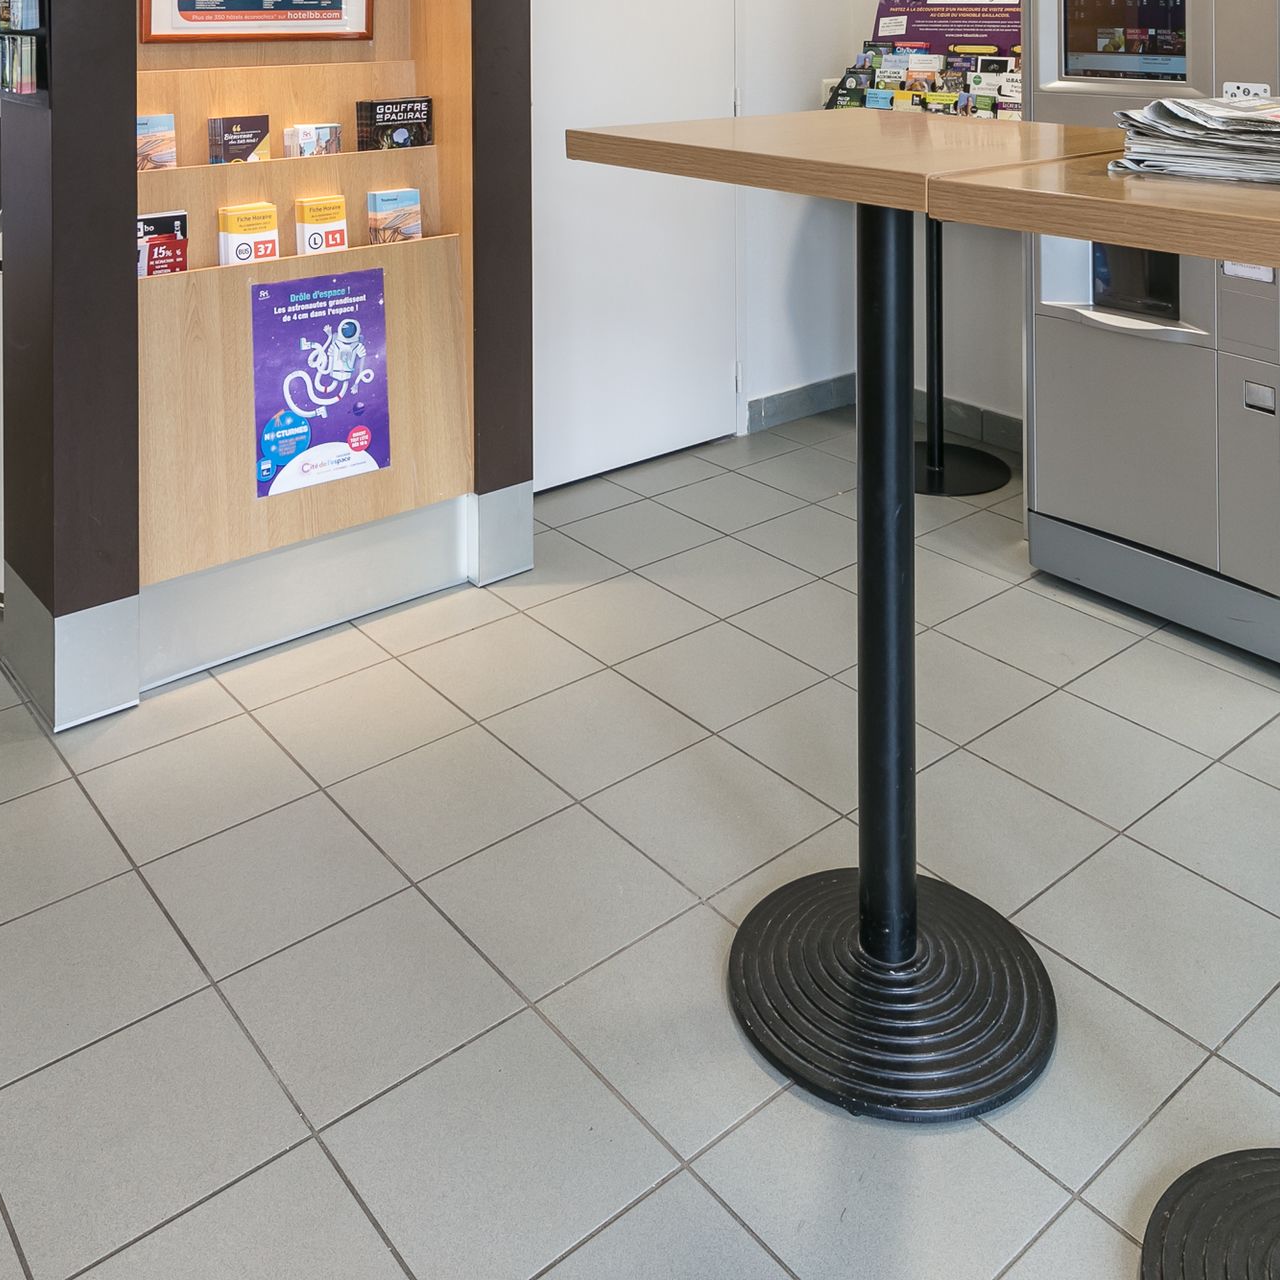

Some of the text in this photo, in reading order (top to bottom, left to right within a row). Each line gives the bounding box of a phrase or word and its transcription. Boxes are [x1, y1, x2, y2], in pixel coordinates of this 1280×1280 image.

[287, 11, 340, 21] hotelbb.com
[376, 102, 428, 113] GOUFFRE
[384, 111, 427, 121] PADIRAC
[328, 235, 340, 245] L1
[152, 245, 172, 259] 15%
[257, 244, 273, 256] 37
[290, 293, 311, 302] Drôle
[312, 288, 345, 300] d'espace
[274, 294, 366, 315] Les astronautes grandissent
[282, 314, 291, 322] de
[310, 310, 326, 318] dans
[327, 306, 354, 317] l'espace
